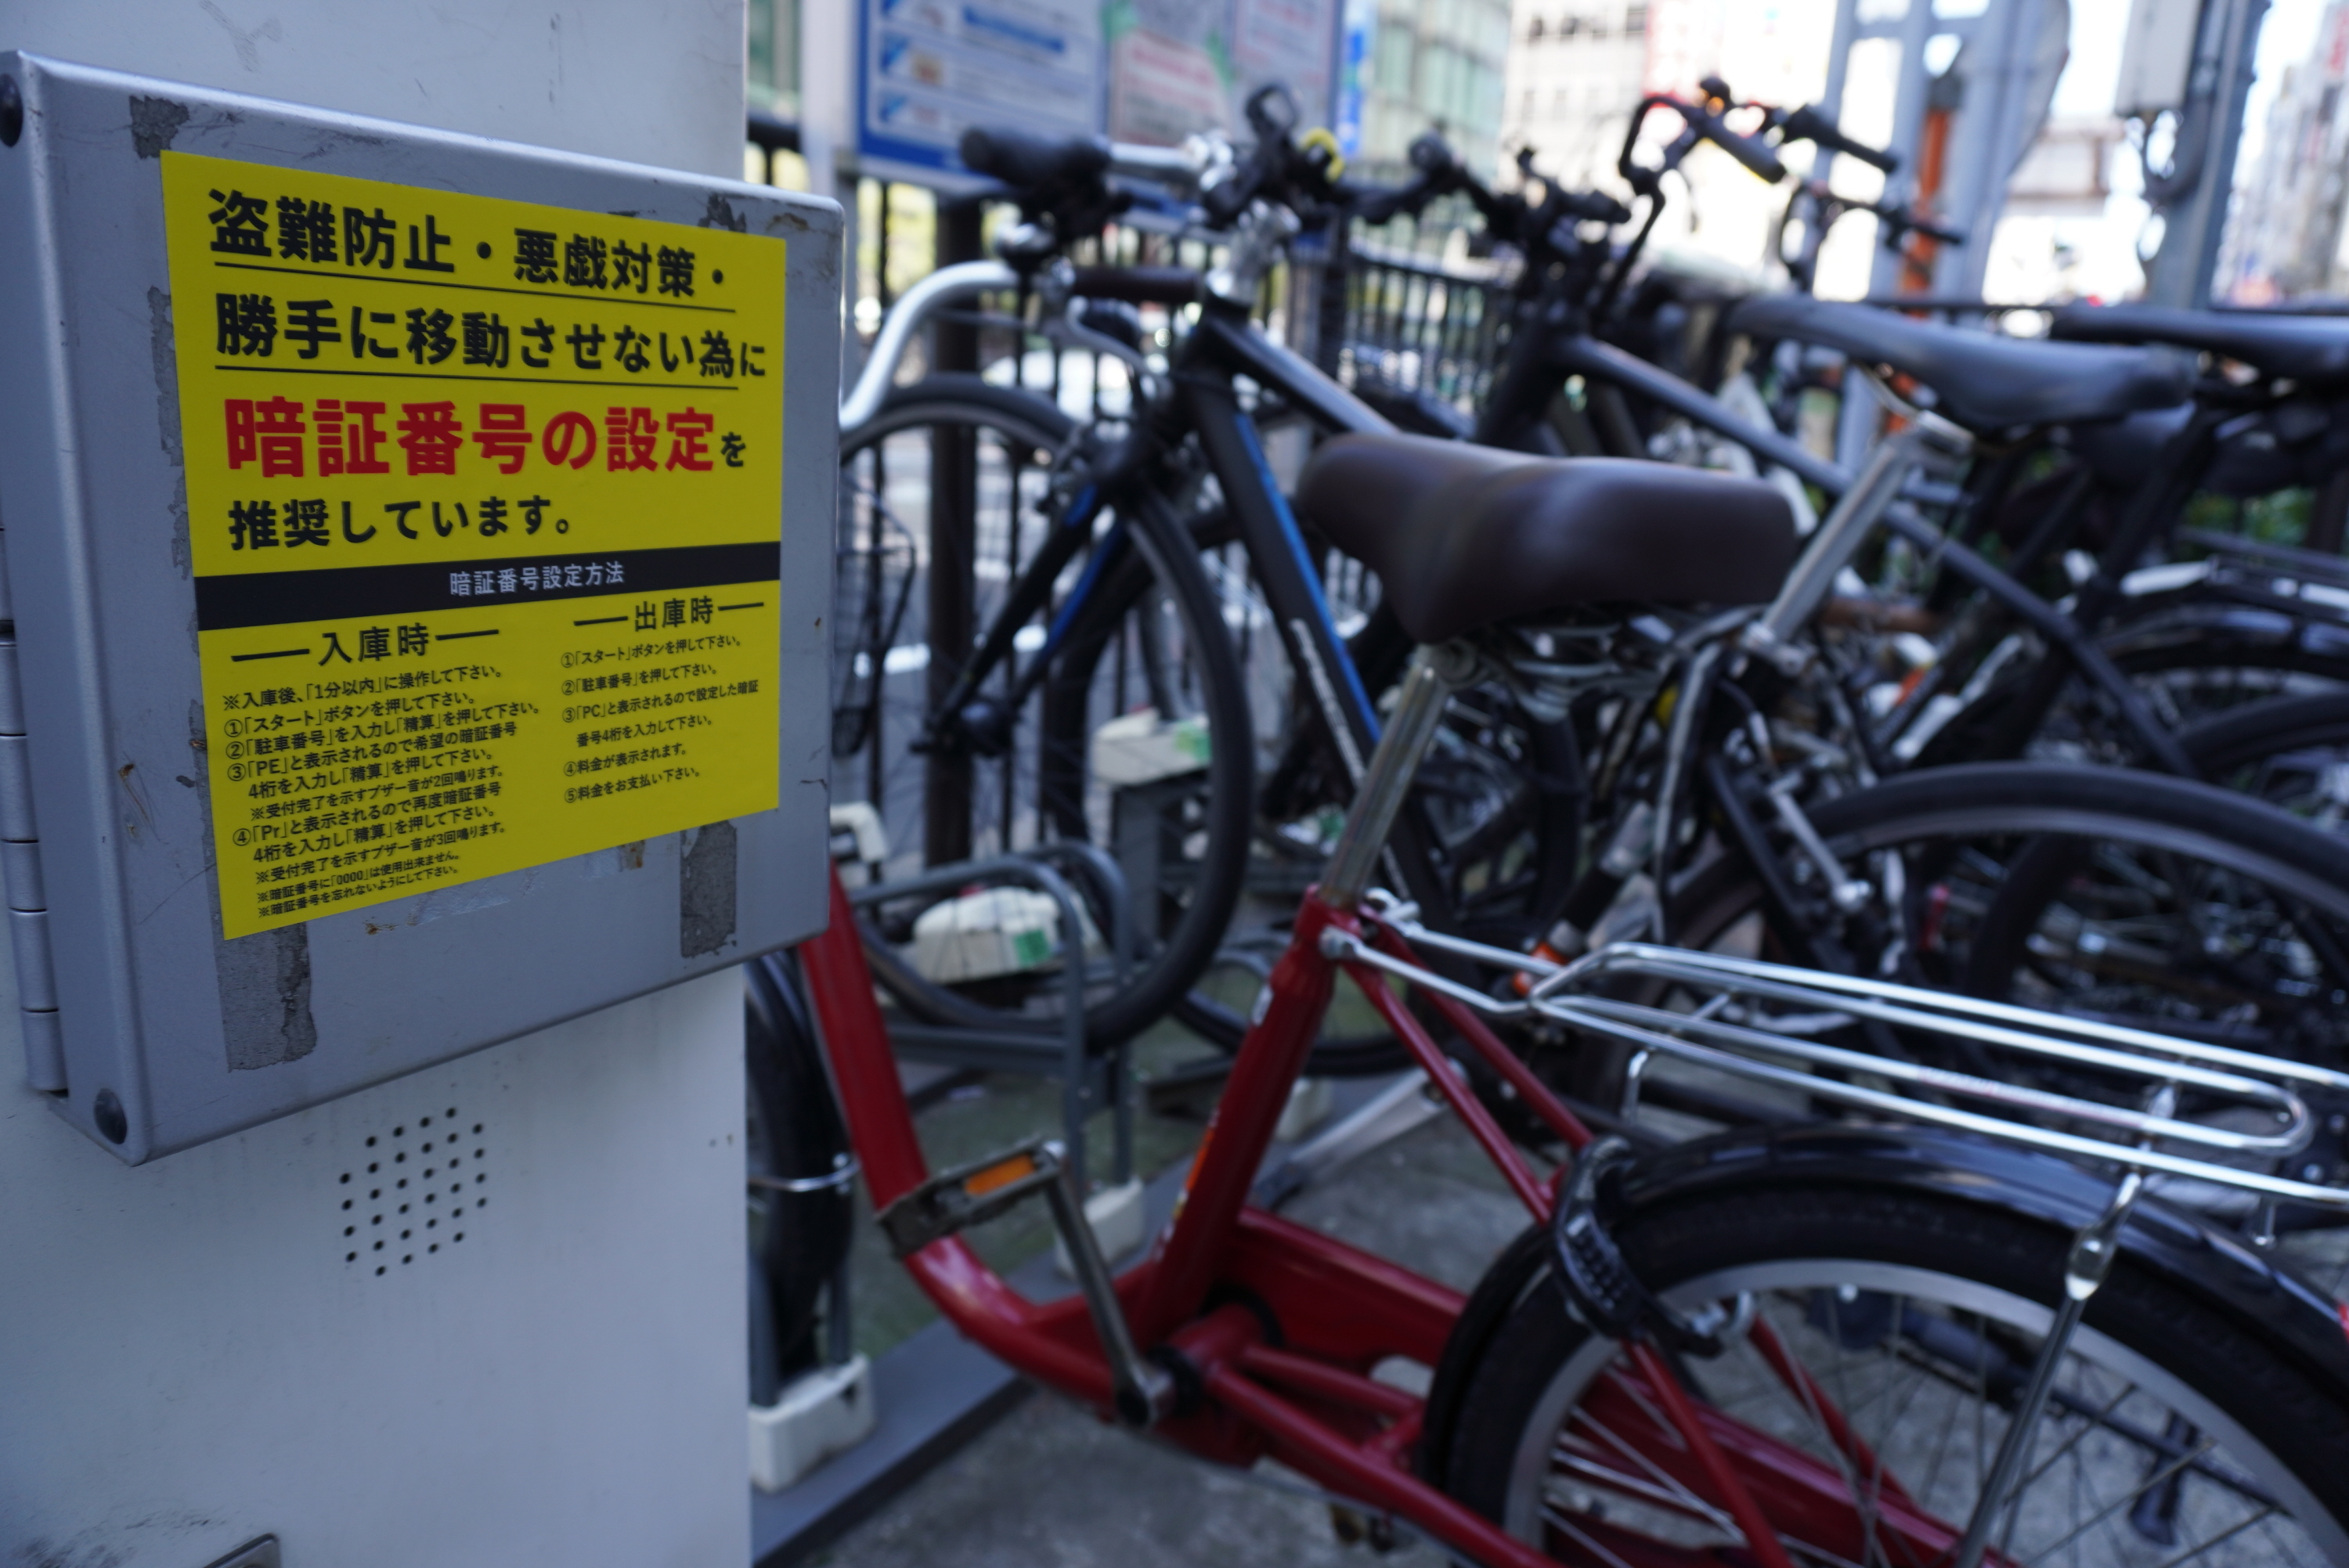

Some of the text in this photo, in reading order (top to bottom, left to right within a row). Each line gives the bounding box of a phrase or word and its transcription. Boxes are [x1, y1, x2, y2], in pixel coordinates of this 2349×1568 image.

[208, 189, 724, 297] 盗難防止・悪戯対策・
[215, 292, 767, 379] 勝手に移動させない為に
[224, 395, 746, 478] 暗証番号の設定を
[228, 495, 570, 550] 推奨しています。
[449, 561, 625, 597] 暗証番号設定方法
[634, 596, 713, 632] 出庫時
[318, 623, 429, 666] 入庫時
